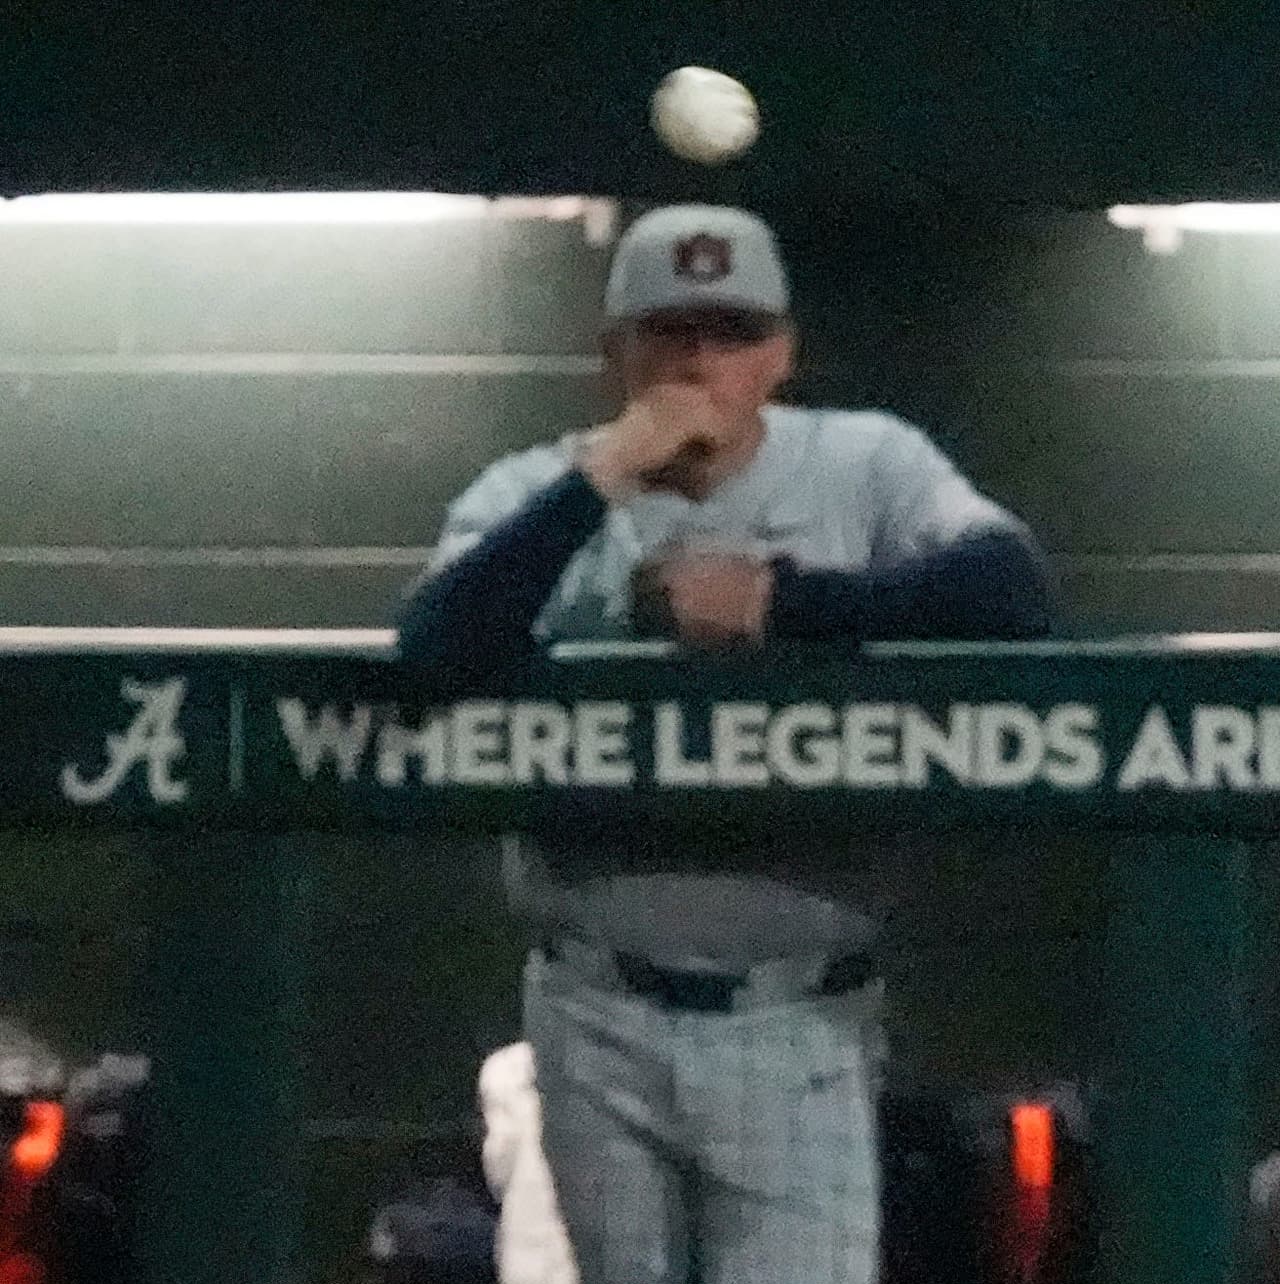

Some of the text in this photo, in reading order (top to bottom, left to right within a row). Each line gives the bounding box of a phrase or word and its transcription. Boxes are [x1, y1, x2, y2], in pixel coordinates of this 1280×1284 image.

[62, 676, 188, 802] A
[277, 698, 635, 787] WHERE
[653, 702, 1105, 789] LEGENDS
